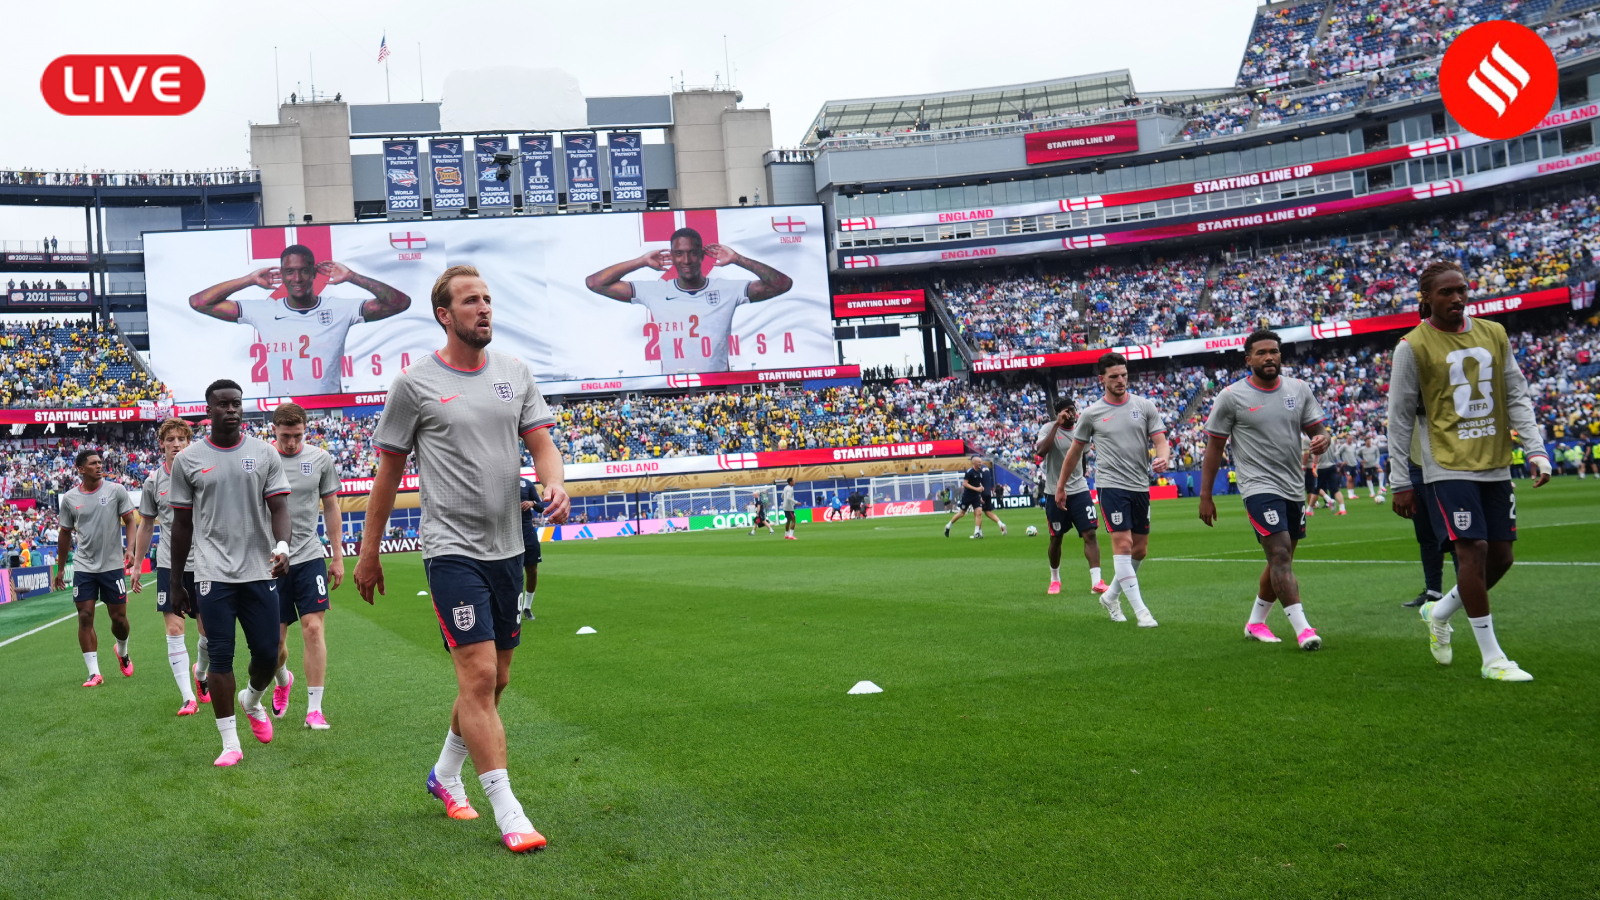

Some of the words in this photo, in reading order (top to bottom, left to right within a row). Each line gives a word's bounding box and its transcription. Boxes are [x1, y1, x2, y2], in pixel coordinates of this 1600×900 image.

[1047, 139, 1085, 149] STARTING
[1086, 136, 1103, 145] LINE
[1194, 174, 1260, 193] STARTING
[1262, 169, 1292, 183] LINE
[1294, 165, 1313, 177] UP
[391, 200, 418, 208] 2001
[939, 209, 994, 222] ENGLAND
[1197, 215, 1263, 231] STARTING
[1266, 210, 1295, 222] LINE
[1298, 206, 1316, 217] UP
[399, 253, 421, 261] ENGLAND
[942, 248, 996, 259] ENGLAND
[26, 292, 47, 301] 2021
[847, 299, 883, 308] STARTING
[884, 298, 900, 306] LINE
[1478, 300, 1504, 314] LINE
[1505, 297, 1522, 309] UP
[659, 322, 683, 332] EZRI
[689, 315, 699, 337] 2
[266, 342, 293, 353] EZRI
[299, 335, 309, 358] 2
[643, 323, 661, 361] 2
[674, 332, 795, 359] KONSA
[250, 343, 268, 383] 2
[282, 352, 410, 381] KONSA
[1004, 358, 1028, 369] LINE
[1030, 357, 1045, 366] UP
[758, 370, 801, 380] STARTING
[803, 369, 822, 378] LINE
[824, 369, 836, 377] UP
[581, 382, 622, 390] ENGLAND
[355, 394, 387, 404] START
[178, 405, 208, 414] GLAND
[1468, 403, 1488, 412] FIFA
[34, 410, 89, 422] STARTING
[92, 411, 117, 420] LINE
[119, 410, 134, 420] UP
[1457, 418, 1486, 429] WORLD
[833, 446, 889, 460] STARTING
[891, 445, 916, 456] LINE
[918, 444, 933, 454] UP
[606, 462, 659, 474] ENGLAND
[885, 501, 920, 514] Coca-Cola
[380, 538, 422, 554] RWAYS
[316, 575, 326, 595] 8
[516, 592, 523, 624] 9
